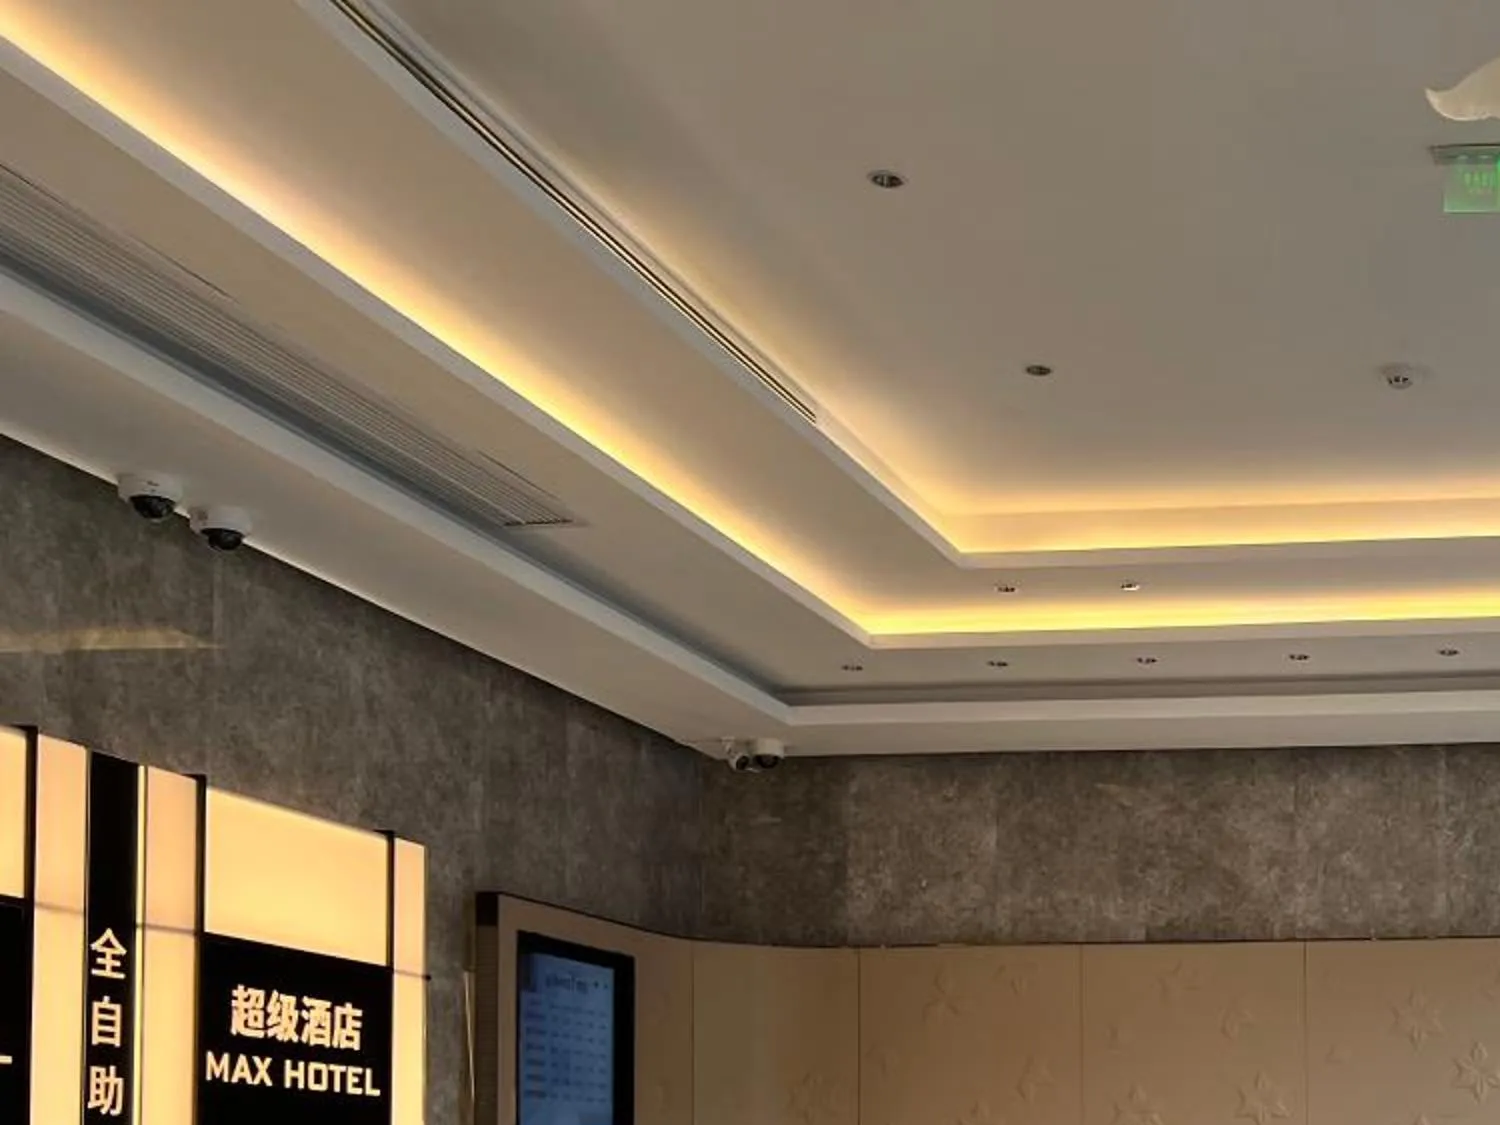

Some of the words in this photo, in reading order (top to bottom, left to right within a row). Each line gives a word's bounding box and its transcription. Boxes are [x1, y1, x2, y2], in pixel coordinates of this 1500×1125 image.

[230, 984, 363, 1051] 超级酒店
[205, 1050, 273, 1087] MAX
[284, 1059, 381, 1097] HOTEL
